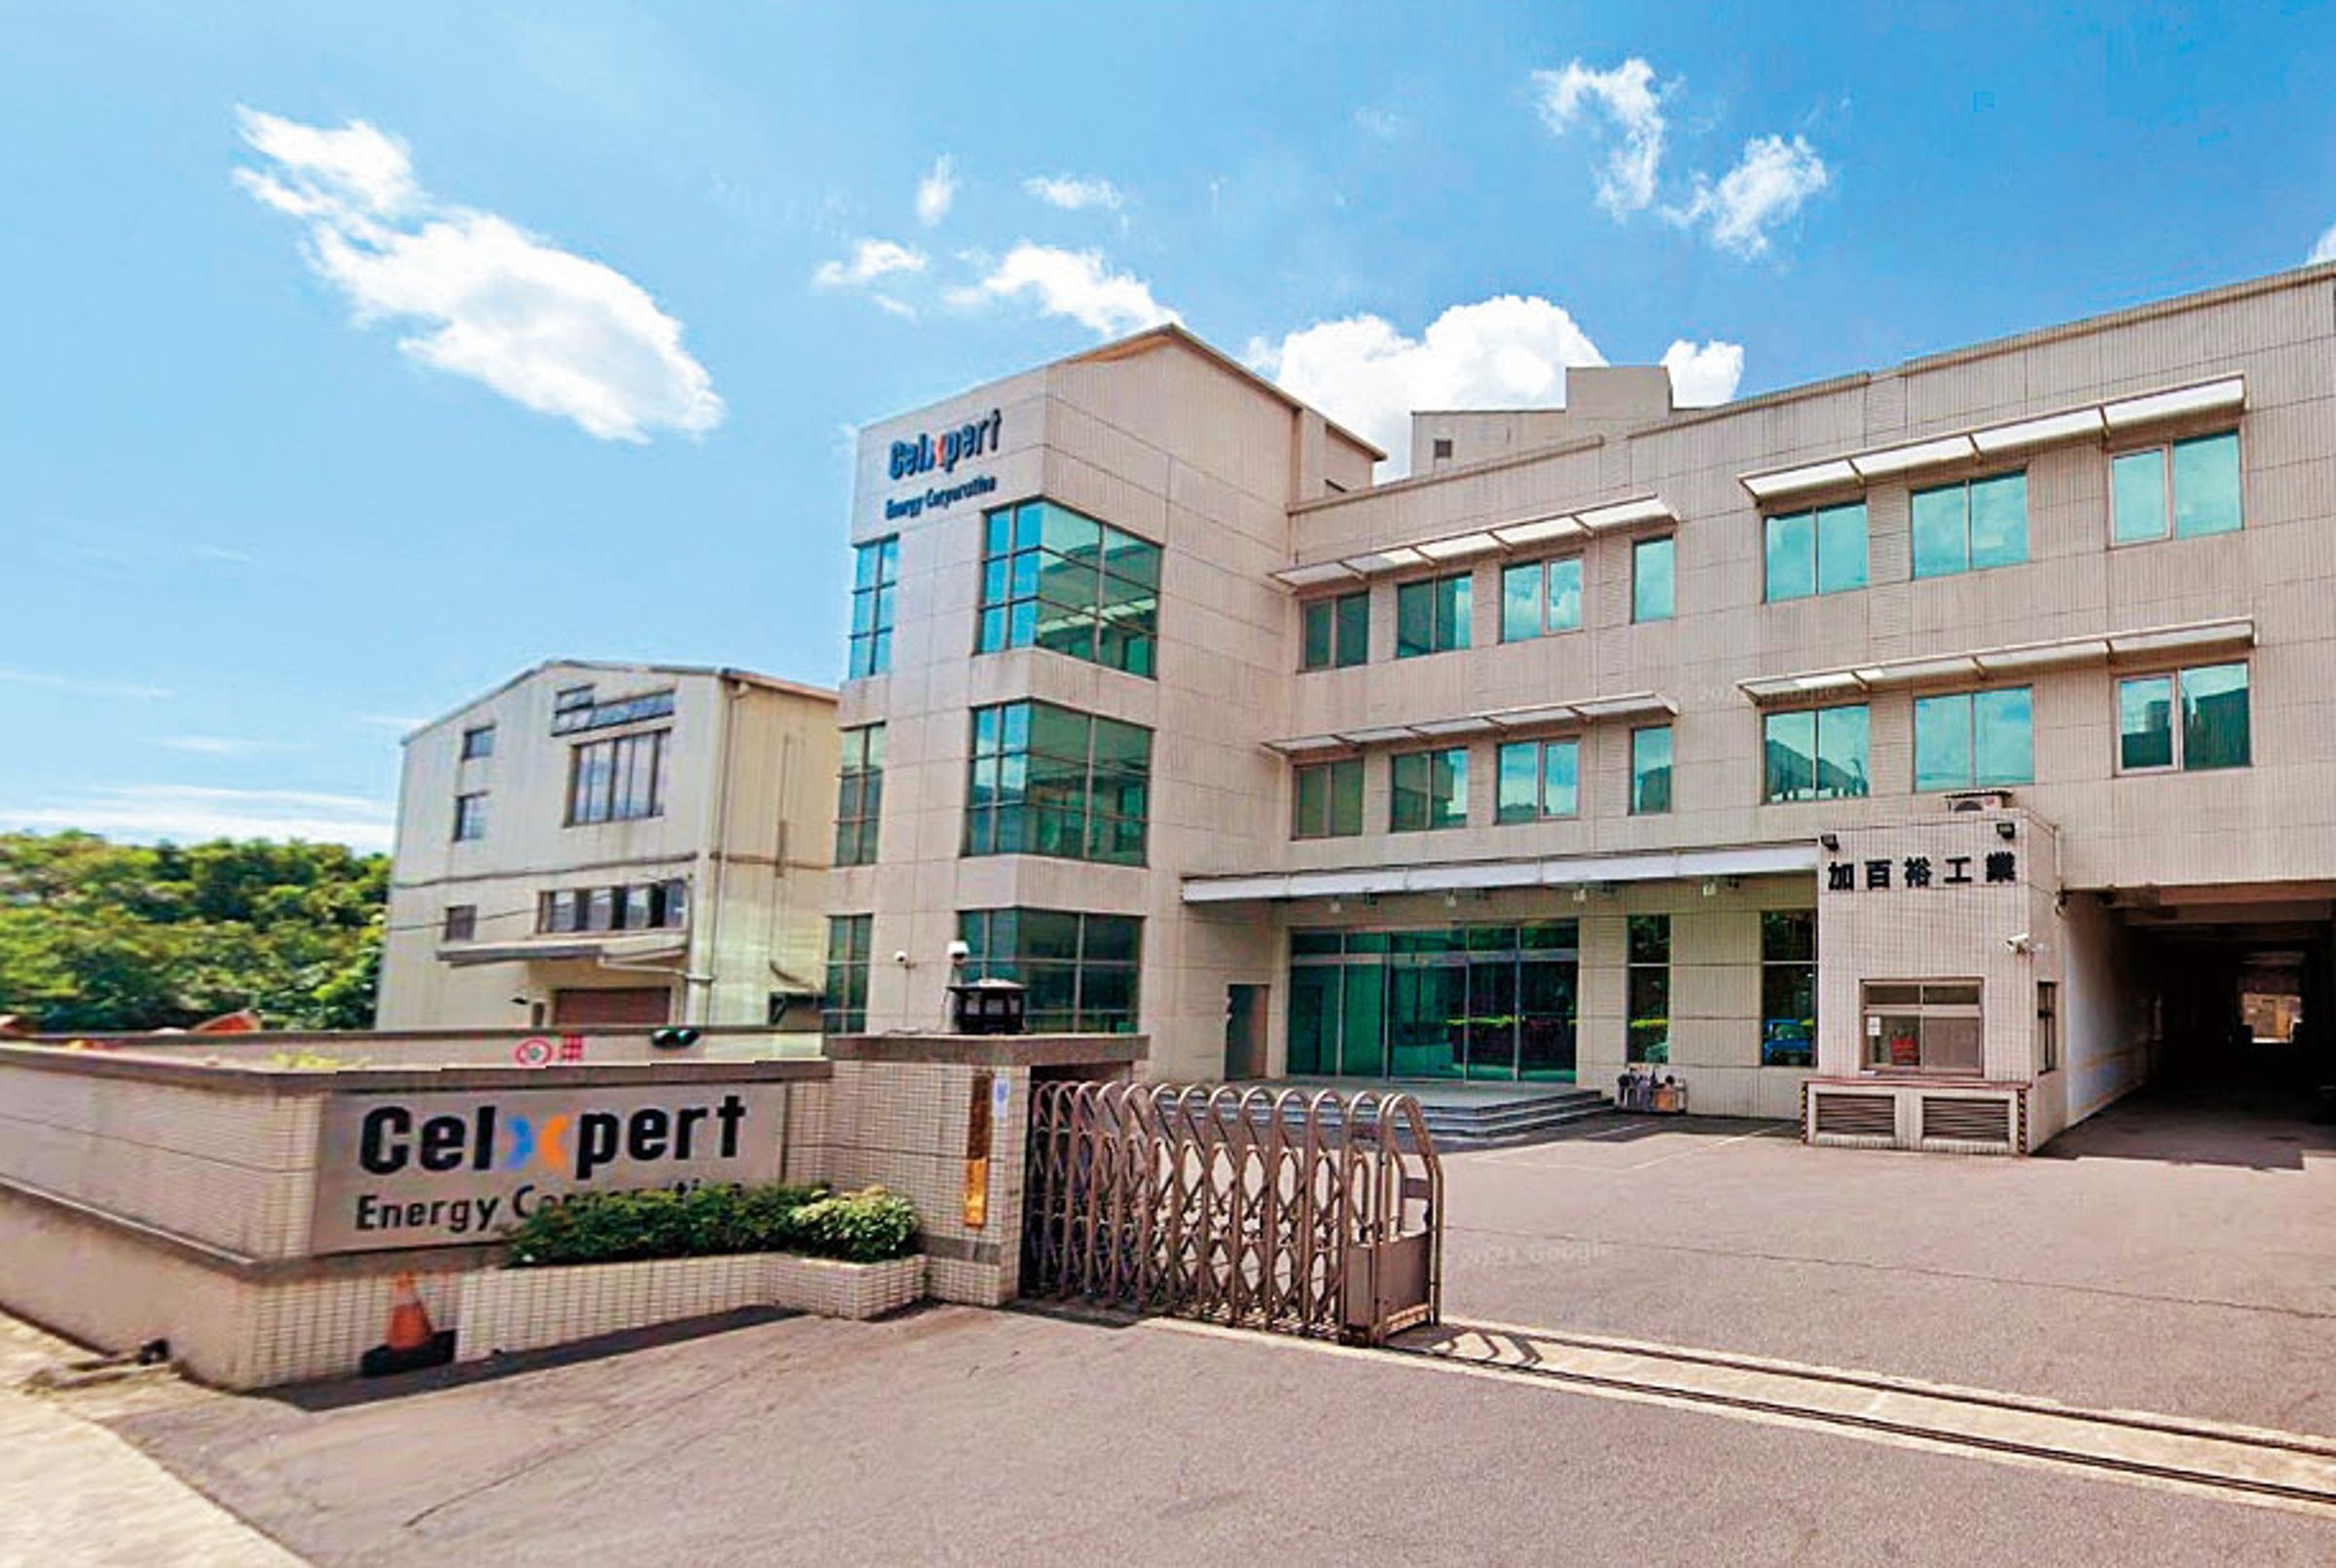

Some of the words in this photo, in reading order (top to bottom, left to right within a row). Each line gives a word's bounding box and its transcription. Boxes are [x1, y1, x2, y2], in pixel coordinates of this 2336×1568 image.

[885, 498, 923, 520] Energy
[926, 476, 996, 509] Corporation
[1828, 852, 2016, 890] 加百裕工業
[357, 1194, 498, 1232] Energy
